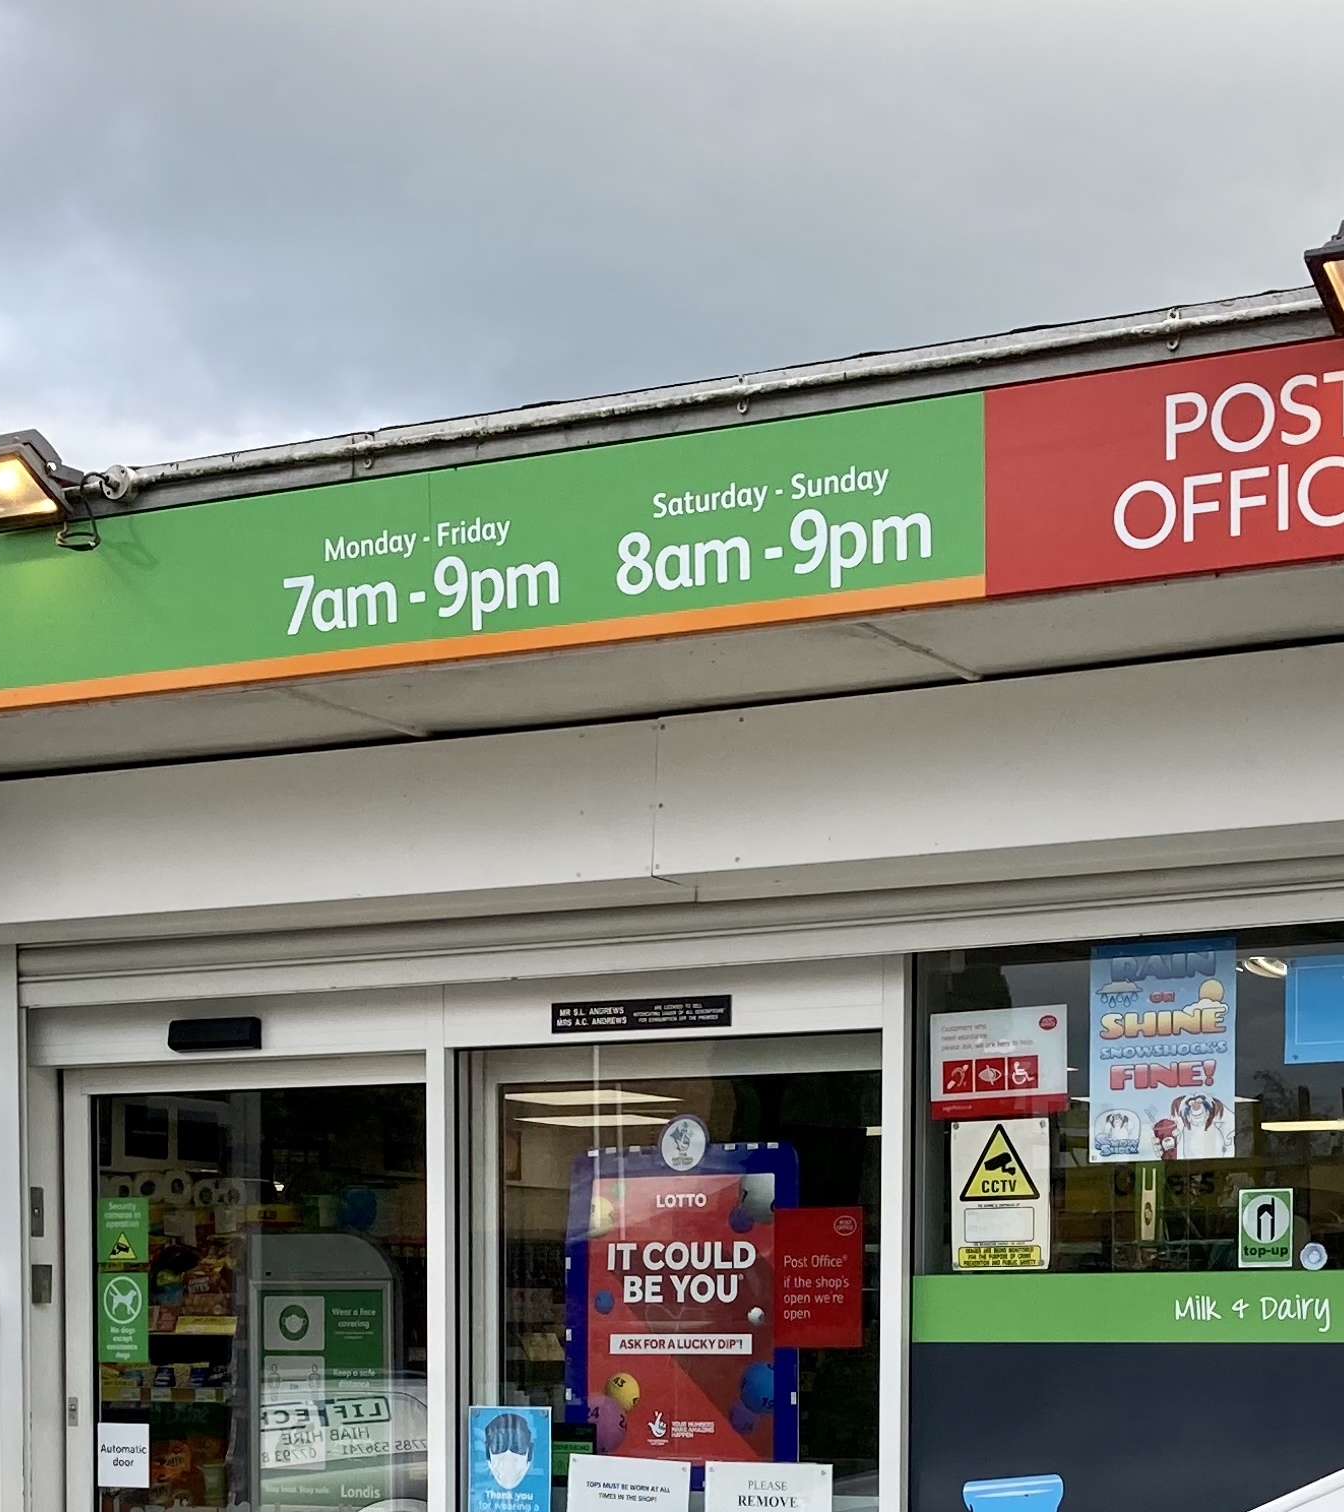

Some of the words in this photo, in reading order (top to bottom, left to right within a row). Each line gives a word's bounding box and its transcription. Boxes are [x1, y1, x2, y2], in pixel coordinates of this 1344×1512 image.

[652, 480, 767, 520] Saturday
[791, 465, 889, 500] Sunday
[324, 530, 416, 561] Monday
[436, 517, 510, 548] Friday
[1110, 950, 1216, 982] RAIN
[1099, 1006, 1227, 1040] SHINE
[1099, 1040, 1228, 1061] SNOWSHOCK'S
[1110, 1059, 1216, 1091] FINE!
[982, 1179, 1017, 1193] CCTV
[108, 1202, 136, 1211] Security
[656, 1193, 706, 1207] LOTTO
[607, 1243, 637, 1271] IT
[642, 1241, 757, 1271] COULD
[1244, 1245, 1288, 1257] top-up
[784, 1255, 808, 1268] Post
[784, 1275, 791, 1288] if
[794, 1276, 812, 1288] the
[623, 1274, 664, 1303] BE
[669, 1274, 740, 1303] YOU
[784, 1294, 811, 1306] open
[332, 1308, 352, 1316] Wear
[360, 1308, 376, 1316] face
[784, 1309, 811, 1321] open
[1175, 1295, 1222, 1321] Milk
[1260, 1294, 1331, 1333] Dairy
[338, 1320, 370, 1329] covering
[619, 1339, 642, 1350] ASK
[644, 1339, 665, 1350] FOR
[667, 1339, 676, 1350] A
[677, 1339, 715, 1350] LUCKY
[101, 1443, 147, 1455] Automatic
[112, 1457, 134, 1467] door
[341, 1485, 380, 1499] Londis
[586, 1481, 602, 1489] TOPS
[602, 1482, 620, 1490] MUST
[630, 1484, 649, 1492] WORN
[748, 1480, 787, 1491] PLEASE
[484, 1490, 512, 1500] Thank
[514, 1492, 534, 1501] you
[617, 1493, 624, 1501] IN
[738, 1495, 798, 1508] REMOVE
[479, 1500, 492, 1510] for
